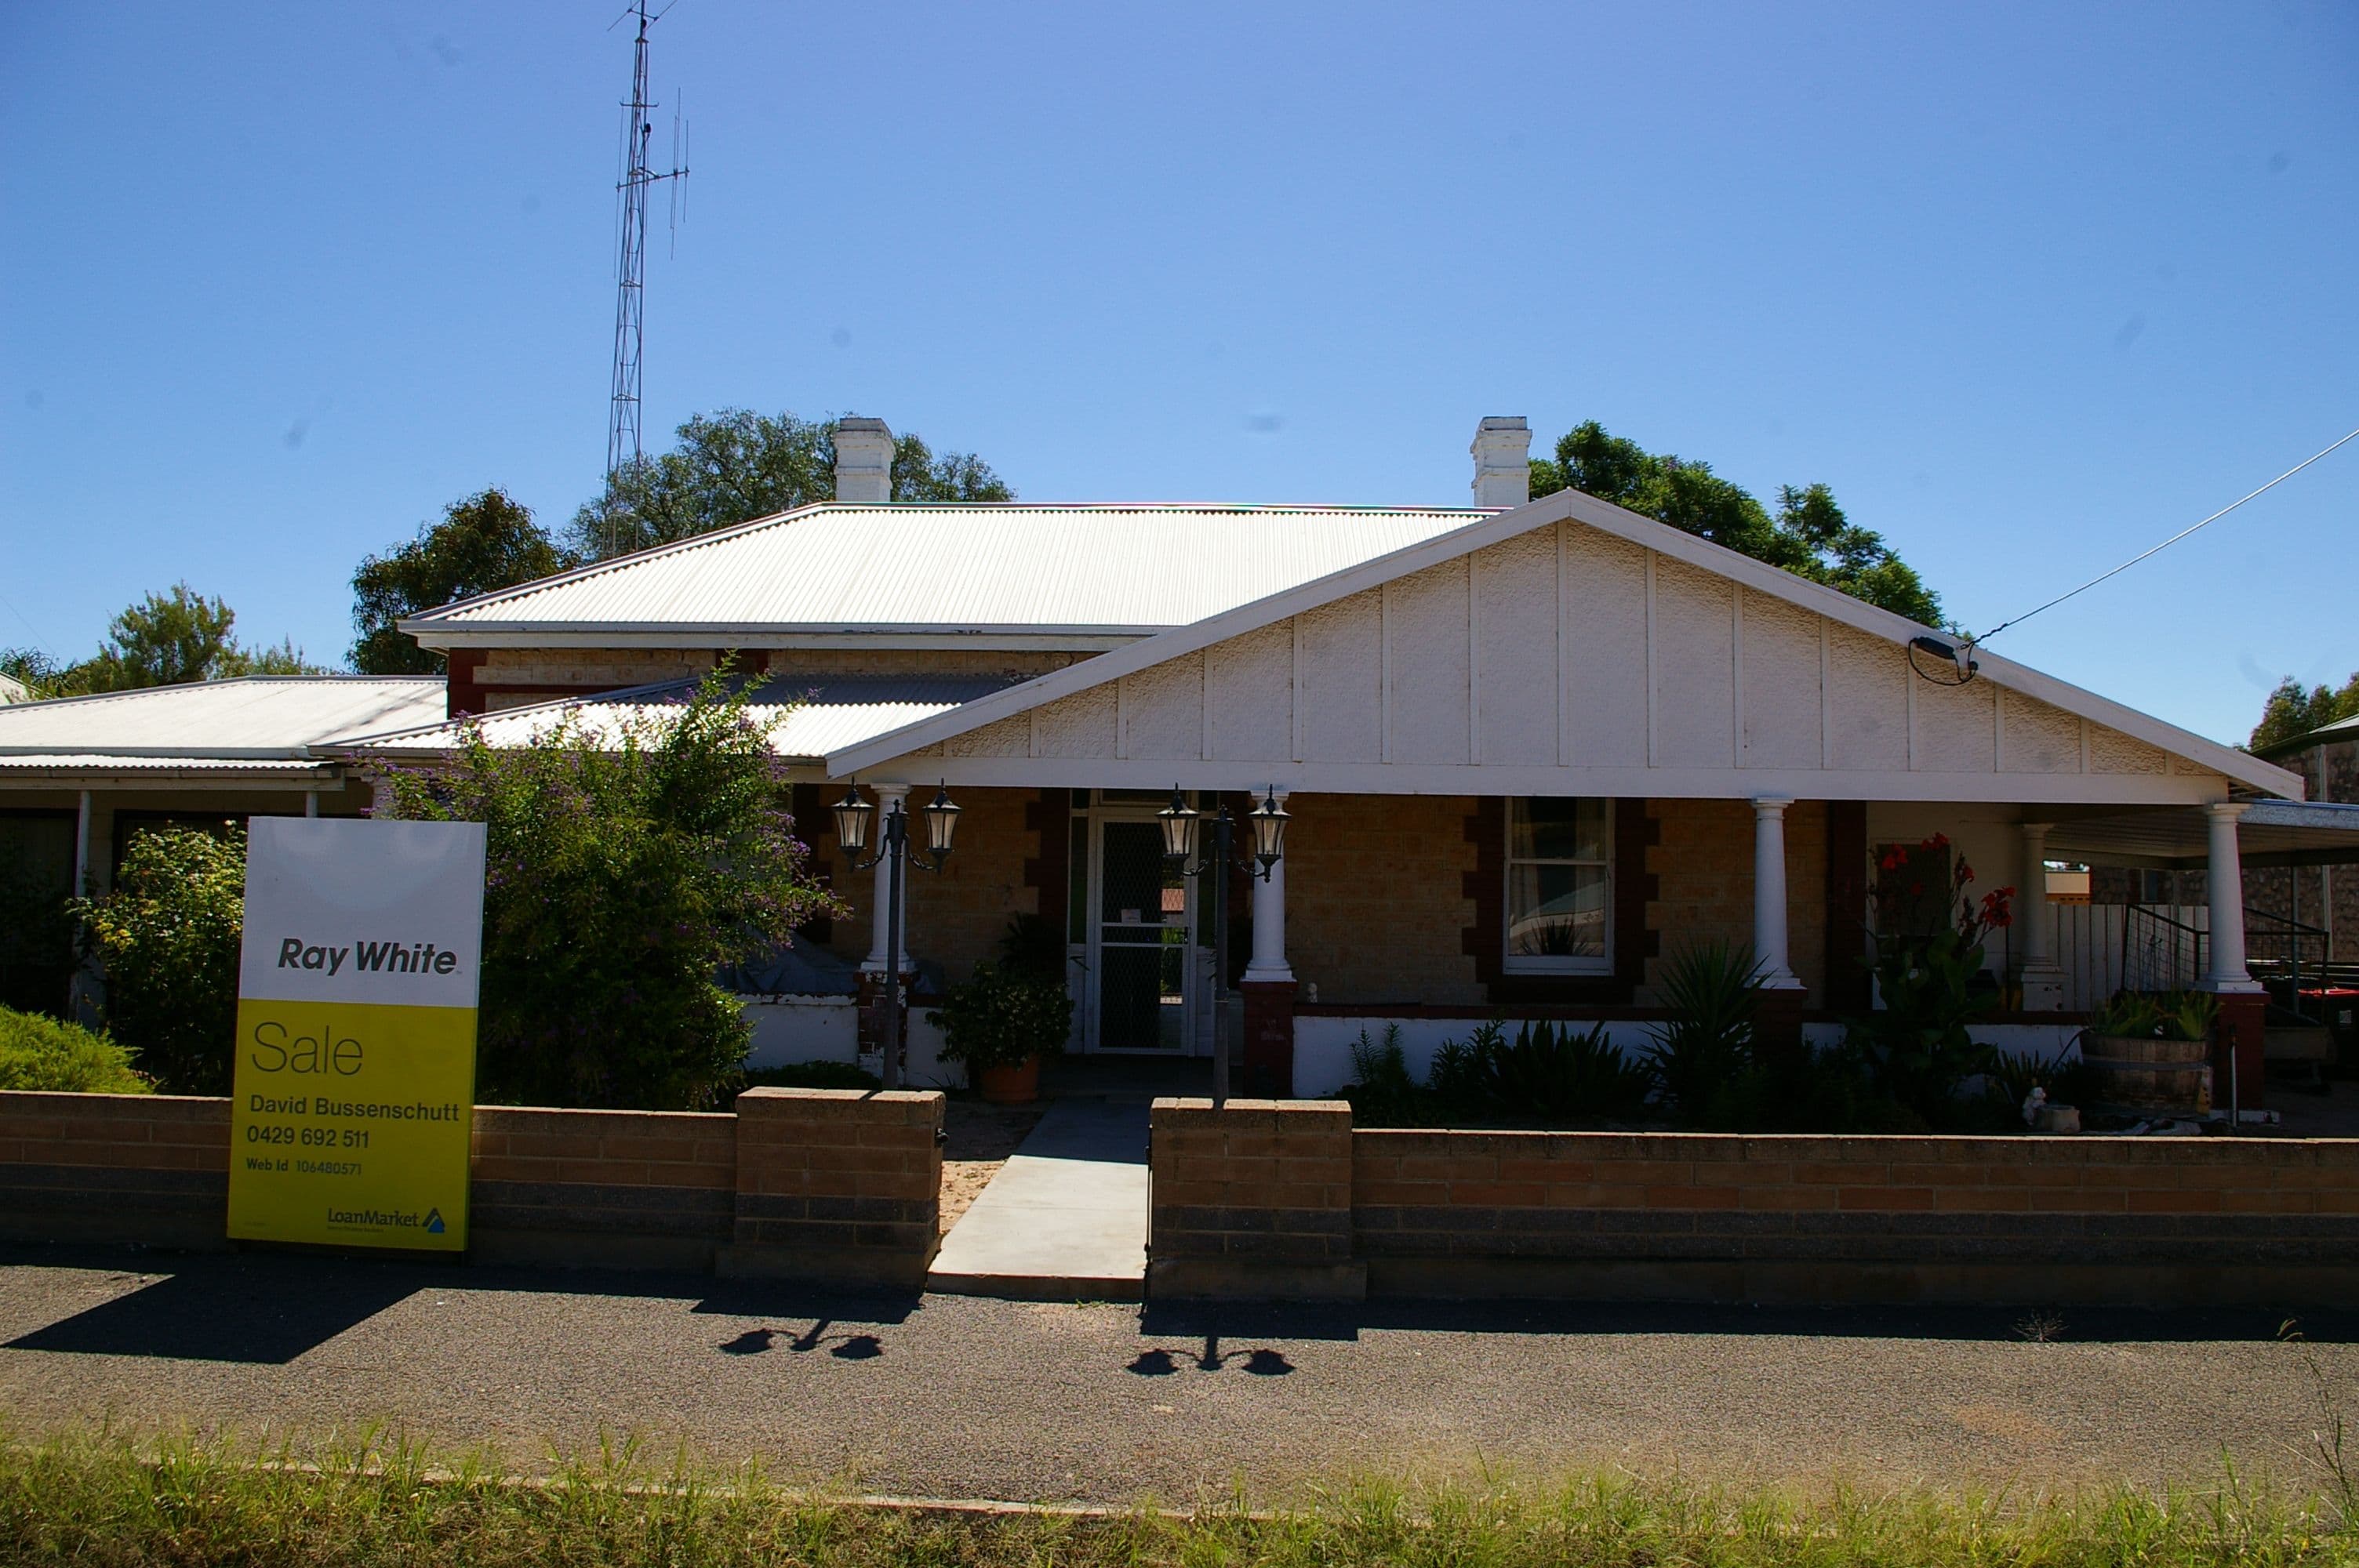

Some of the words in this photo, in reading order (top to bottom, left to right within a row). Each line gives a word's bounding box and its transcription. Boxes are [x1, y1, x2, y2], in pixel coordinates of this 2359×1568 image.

[278, 938, 349, 976] Ray
[357, 941, 457, 975] White
[252, 1021, 363, 1076] Sale
[250, 1094, 307, 1114] David
[315, 1098, 460, 1121] Bussenschutt
[247, 1126, 294, 1144] 0429
[301, 1128, 337, 1147] 692
[343, 1130, 369, 1148] 511
[246, 1158, 273, 1171] Web
[276, 1159, 289, 1171] Id
[327, 1207, 420, 1227] LoanMarket
